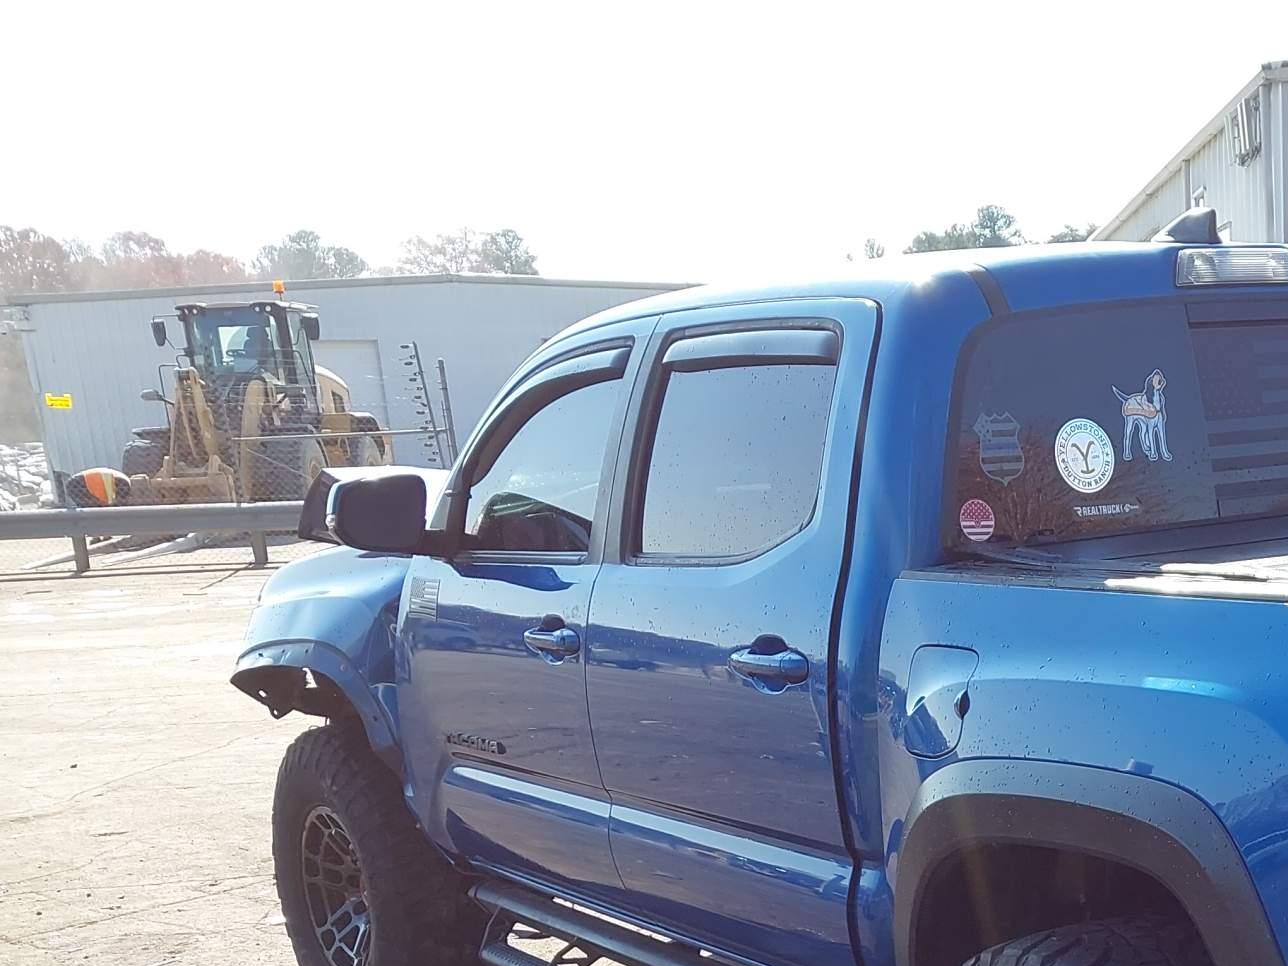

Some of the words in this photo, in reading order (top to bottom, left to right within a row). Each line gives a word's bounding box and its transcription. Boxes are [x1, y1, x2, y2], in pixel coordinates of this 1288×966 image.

[1059, 423, 1109, 457] YELLOWSTONE
[1063, 465, 1093, 488] DUTTON
[1094, 460, 1111, 486] RANCH
[1082, 503, 1121, 516] REALTRUCK
